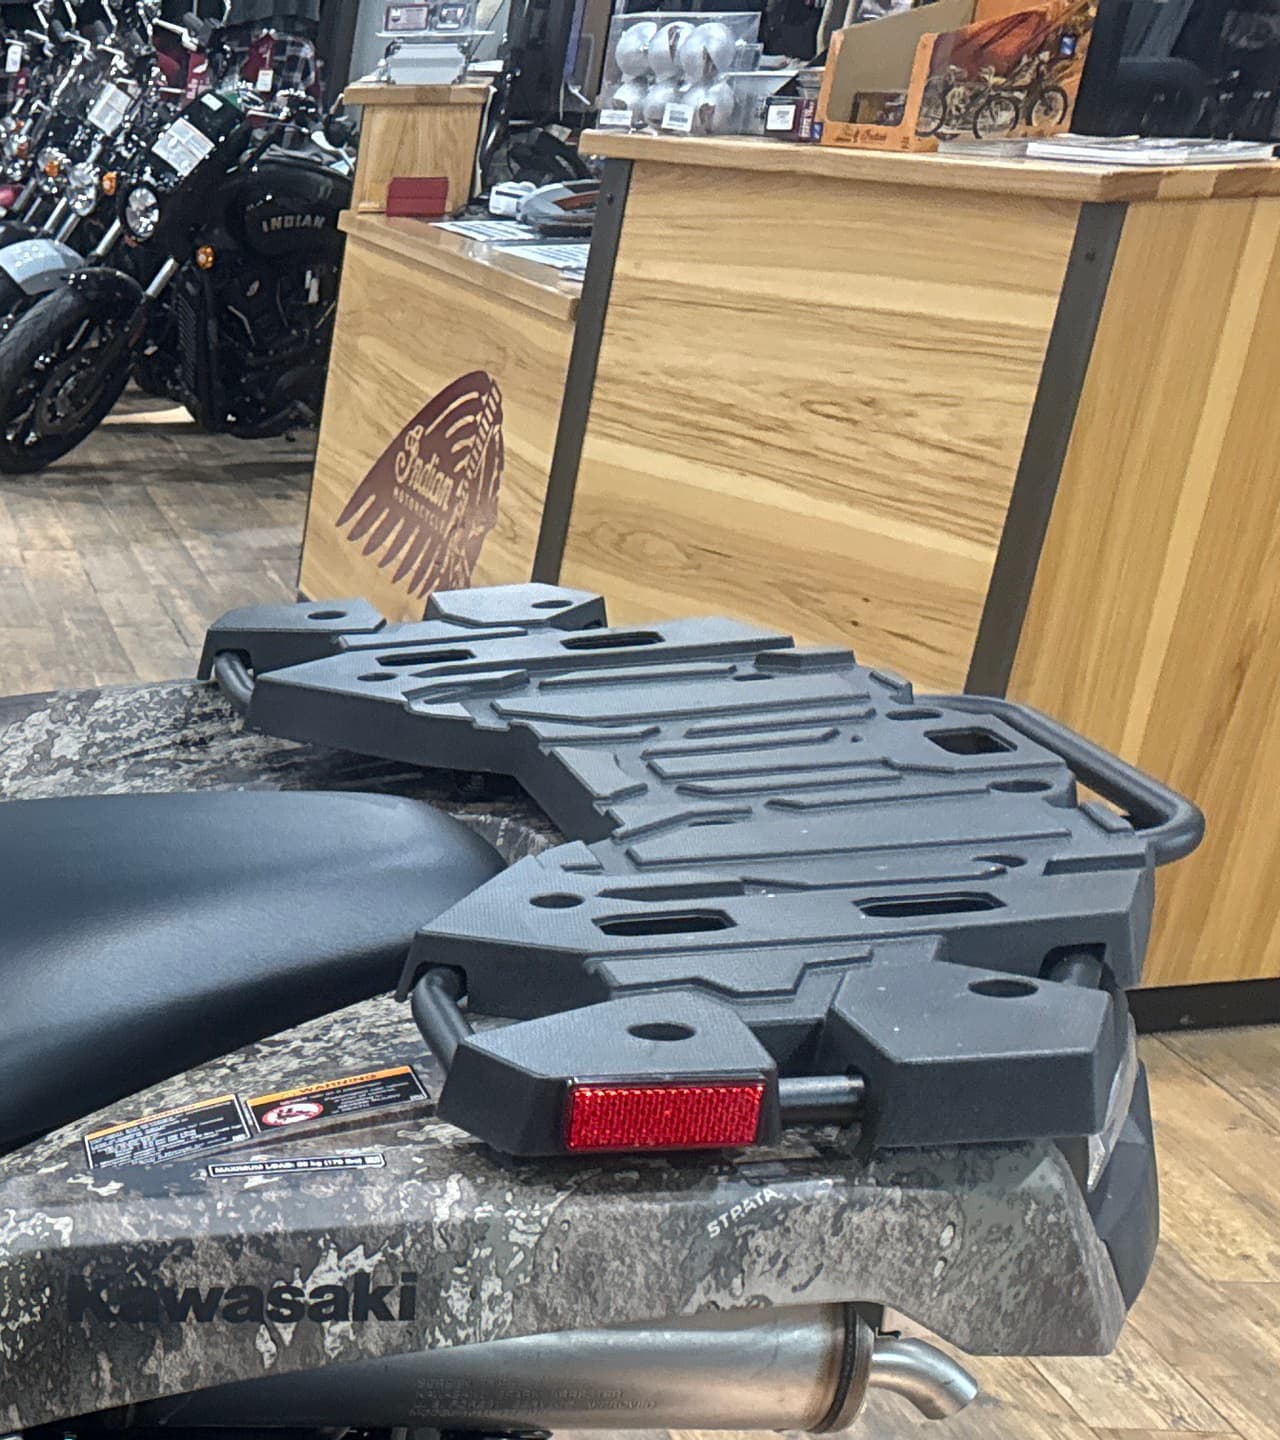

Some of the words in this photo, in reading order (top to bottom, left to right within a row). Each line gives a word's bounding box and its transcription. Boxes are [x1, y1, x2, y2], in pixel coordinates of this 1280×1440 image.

[262, 214, 326, 233] INDIAN
[395, 424, 454, 512] Indian
[705, 1185, 778, 1239] STRATA
[68, 1271, 418, 1324] Kawasaki
